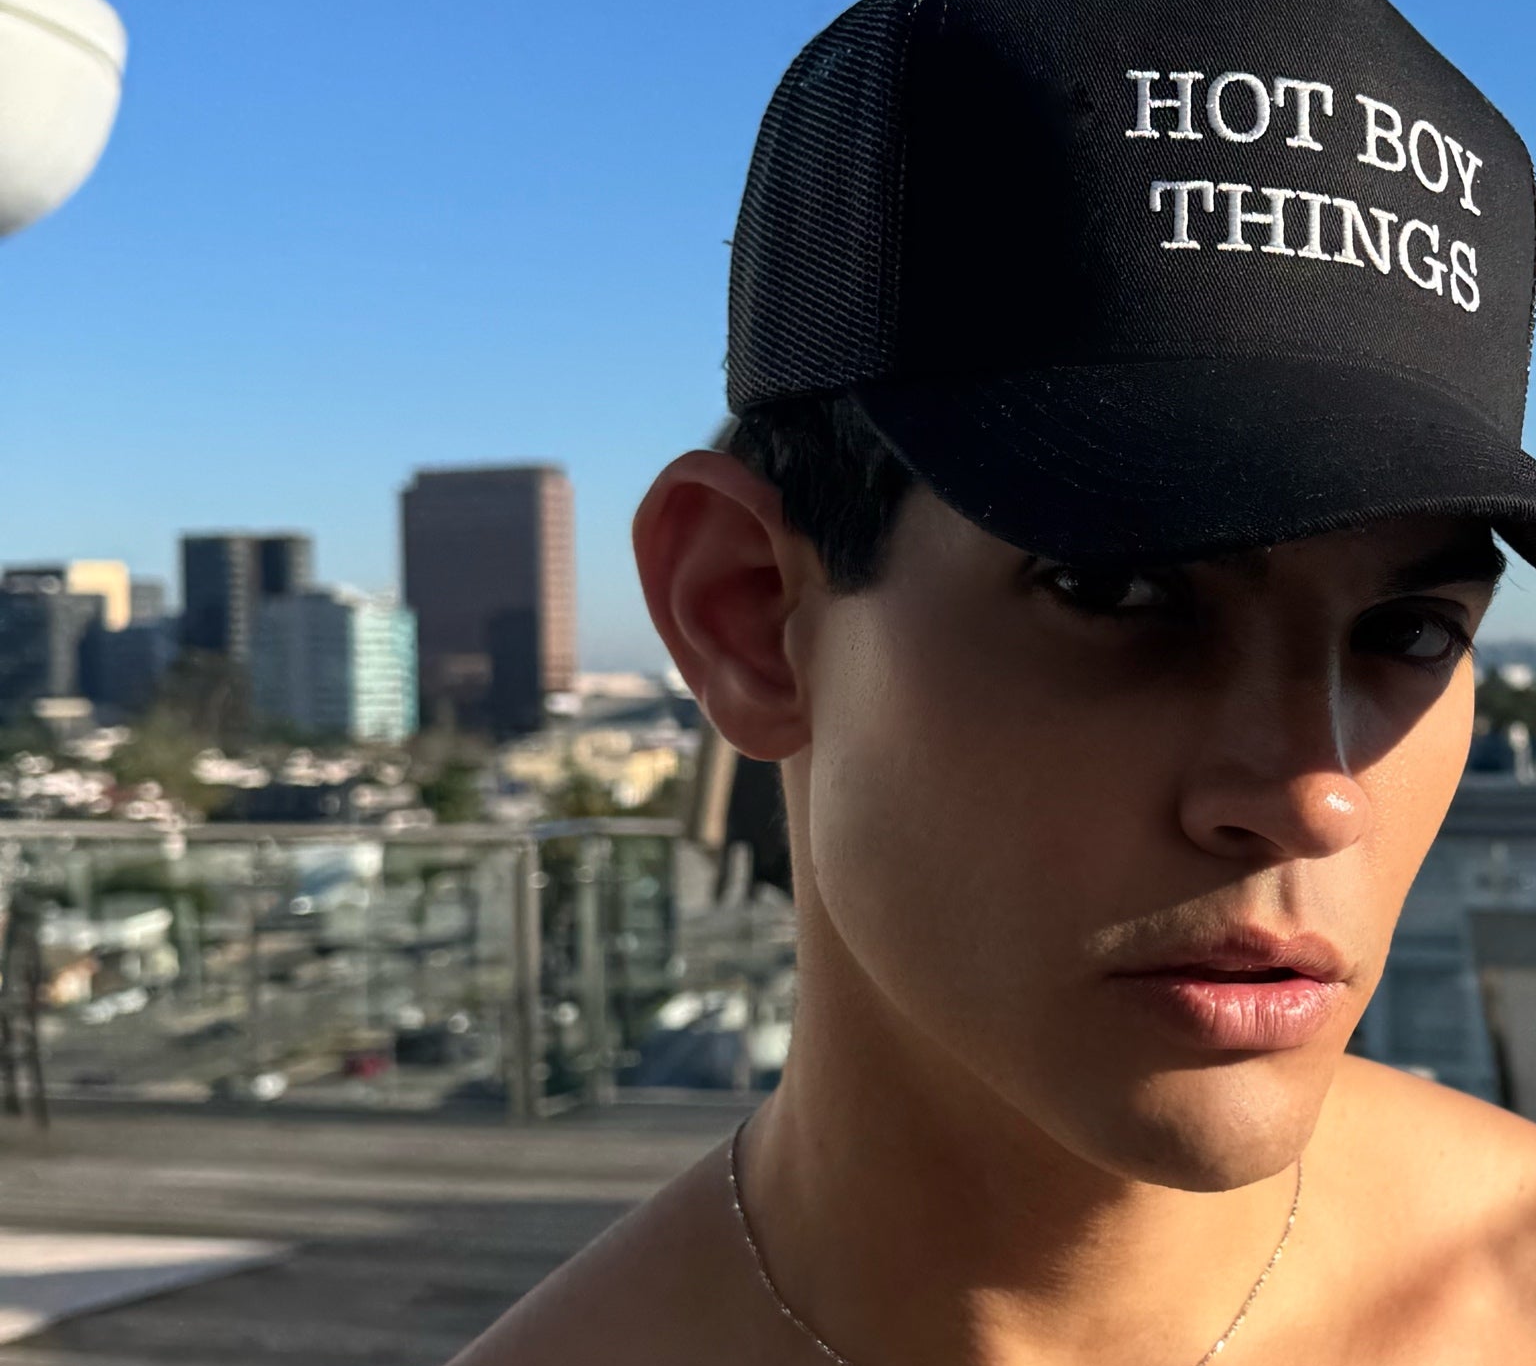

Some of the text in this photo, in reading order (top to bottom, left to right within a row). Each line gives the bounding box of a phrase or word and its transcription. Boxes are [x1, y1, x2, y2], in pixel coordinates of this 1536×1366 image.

[1125, 69, 1483, 217] HOT BOY
[1149, 180, 1481, 312] THINGS
